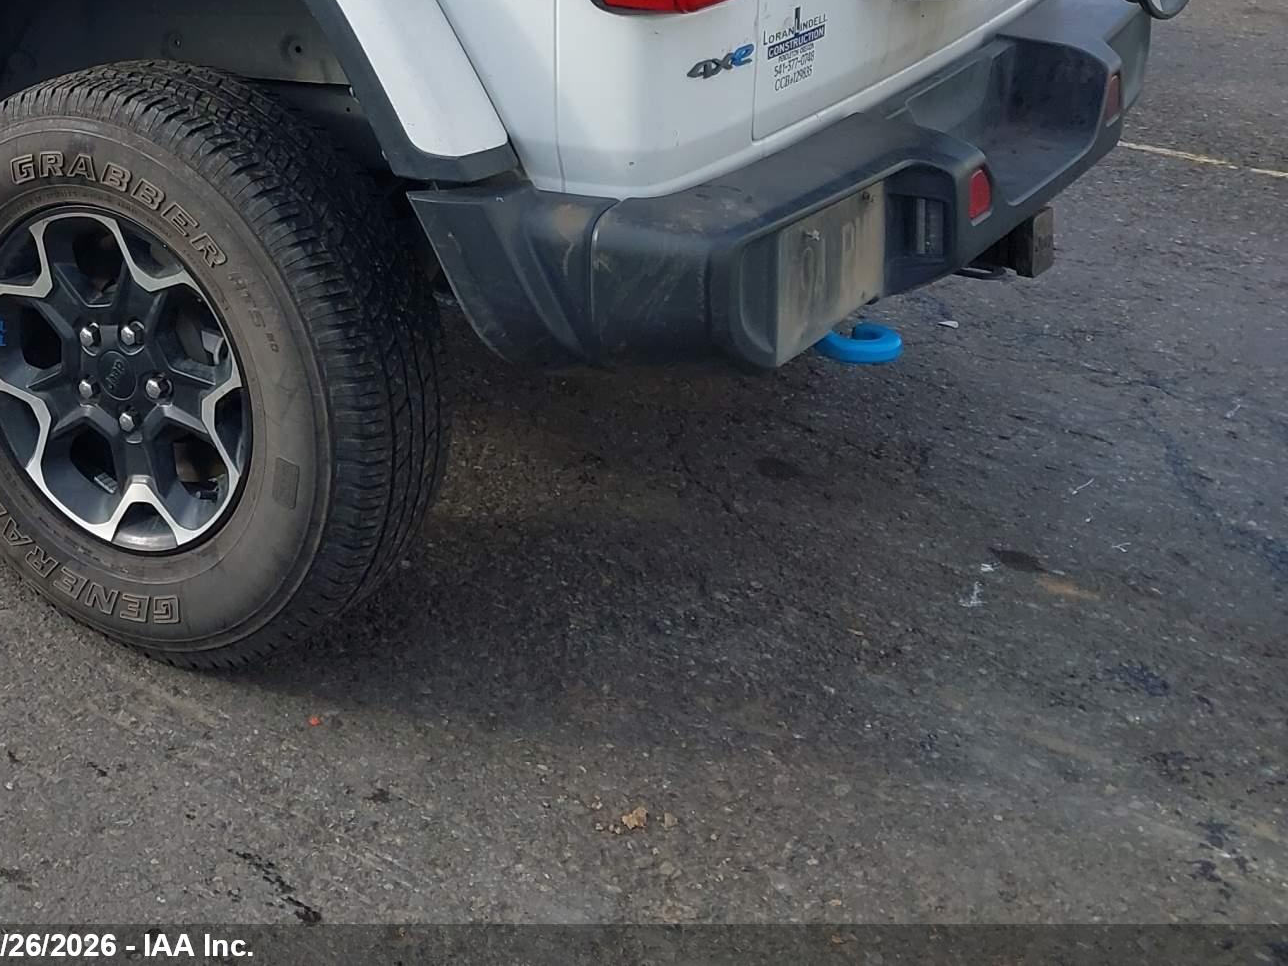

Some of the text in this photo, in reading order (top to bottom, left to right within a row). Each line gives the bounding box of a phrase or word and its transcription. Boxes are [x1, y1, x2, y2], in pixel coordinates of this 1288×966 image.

[763, 27, 795, 46] LORAN
[768, 26, 825, 58] CONSTRUCTION
[686, 43, 755, 79] 4xe
[9, 150, 228, 268] GRABBER
